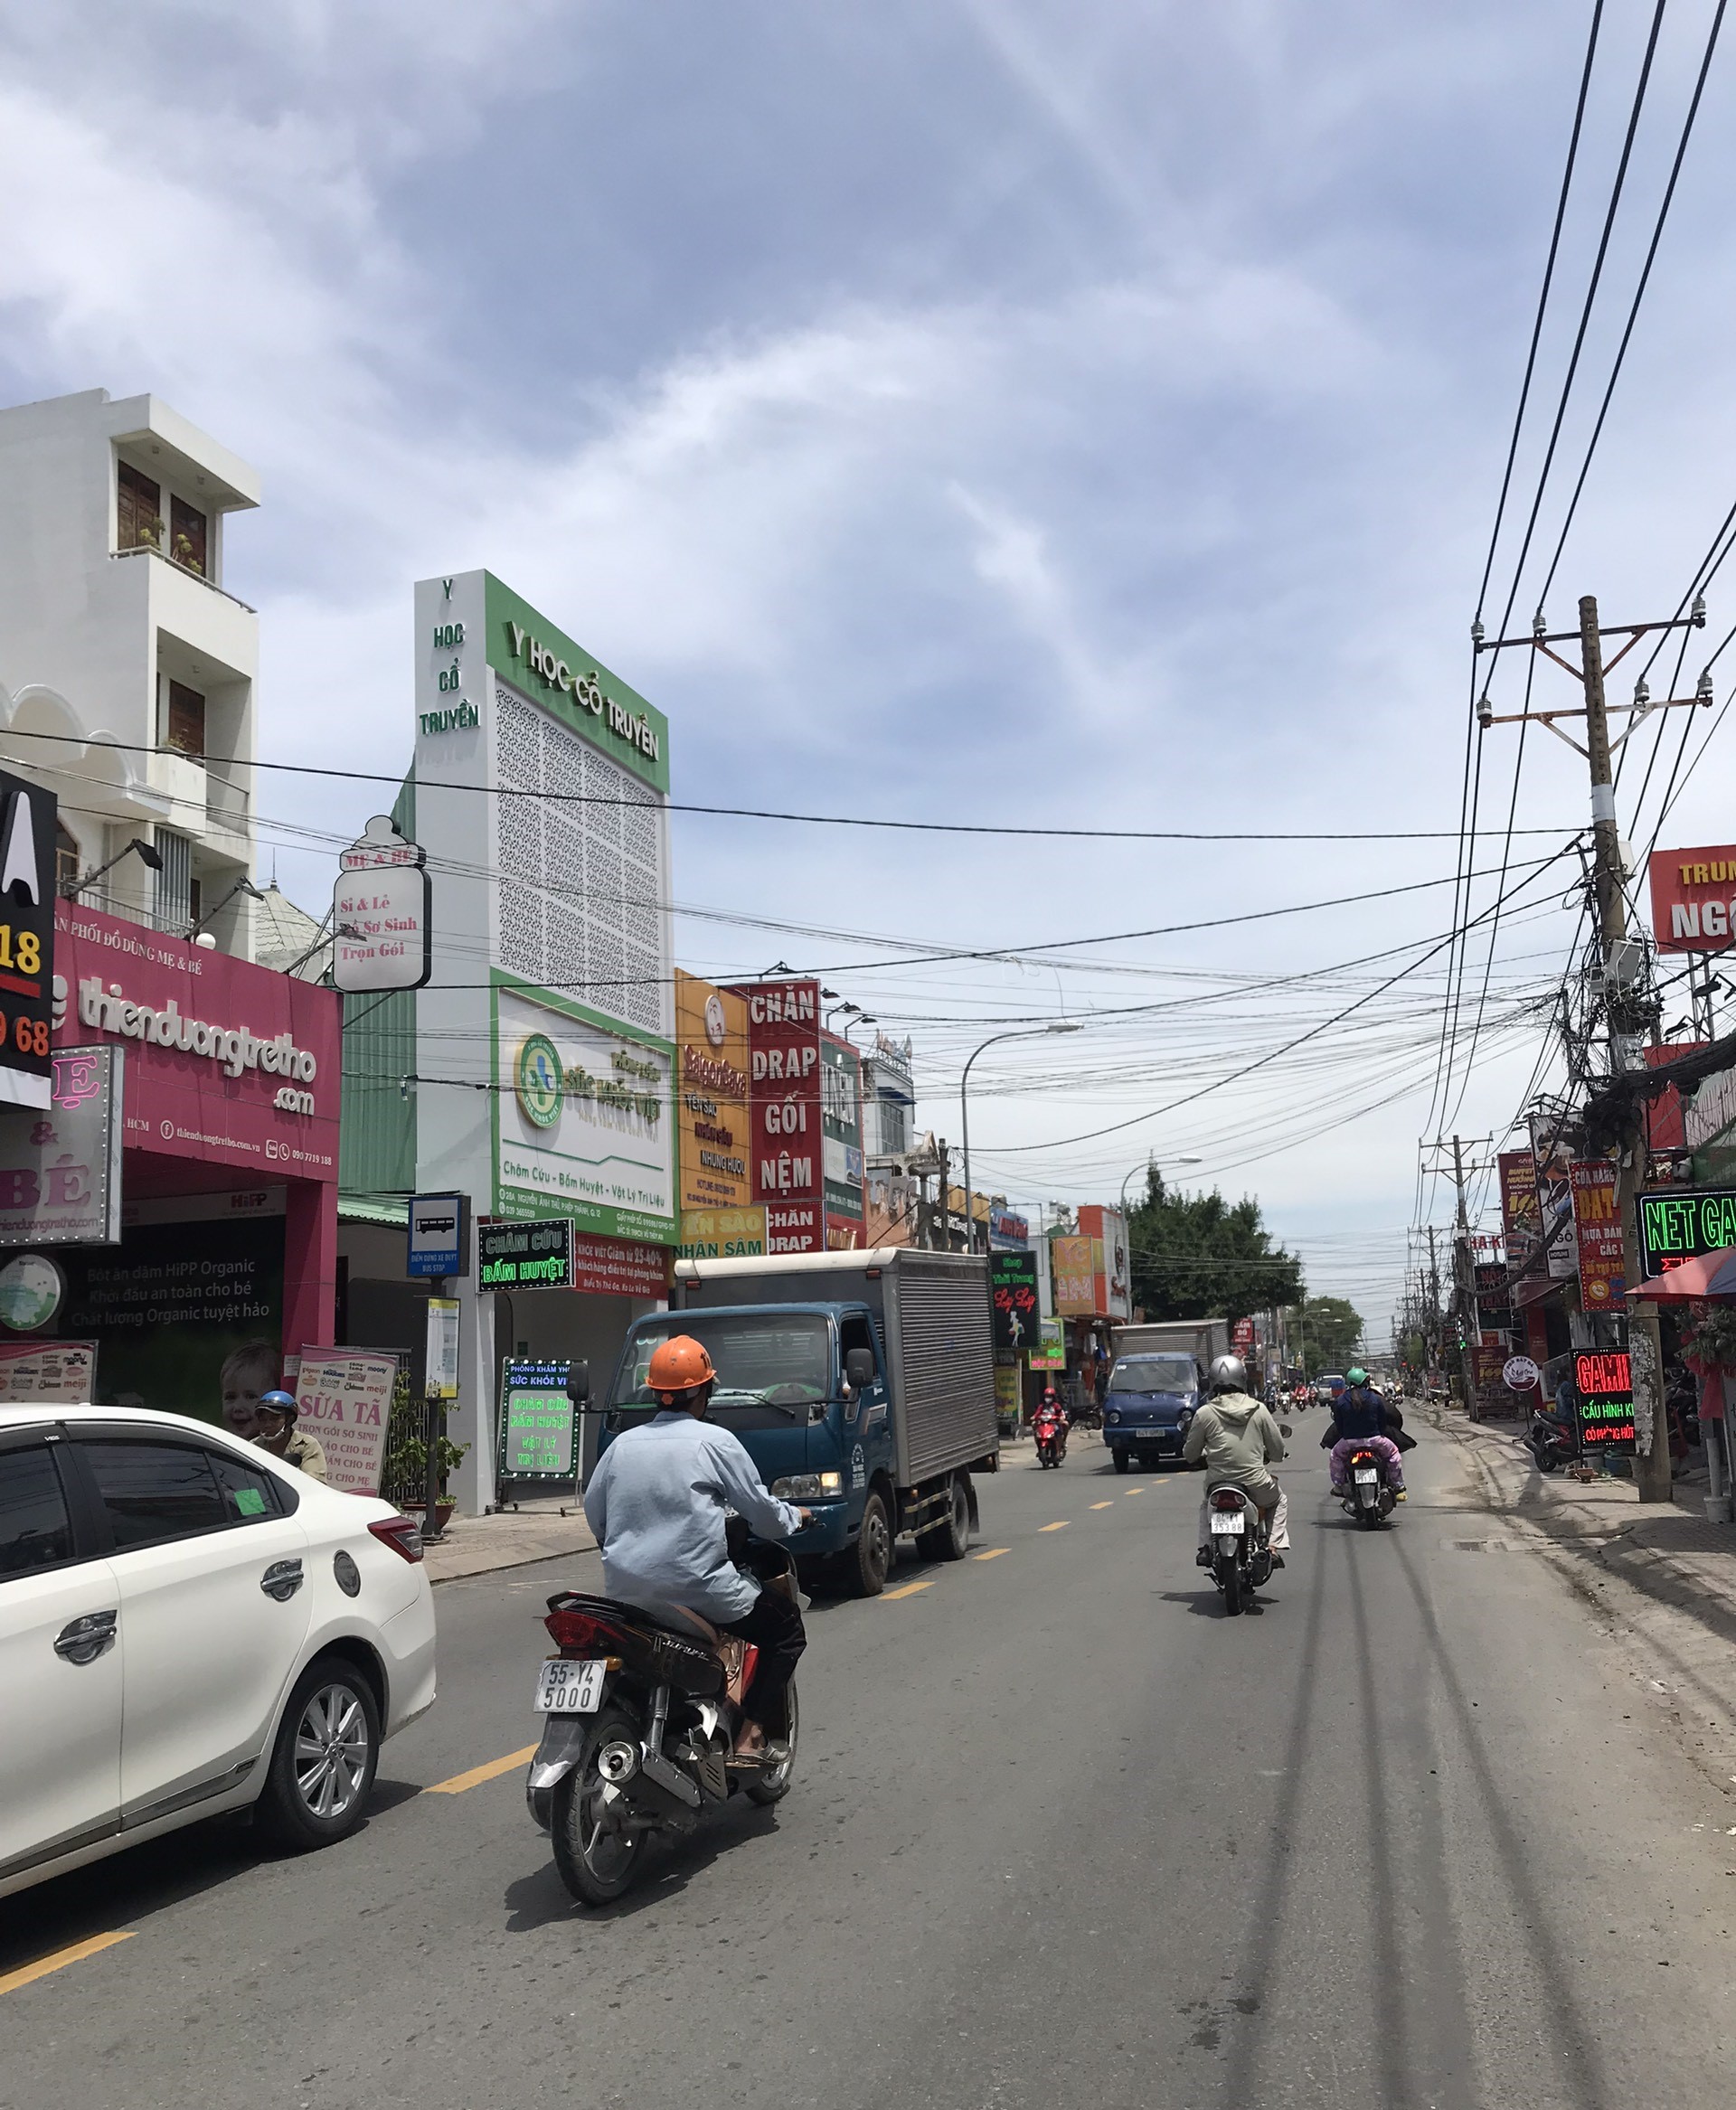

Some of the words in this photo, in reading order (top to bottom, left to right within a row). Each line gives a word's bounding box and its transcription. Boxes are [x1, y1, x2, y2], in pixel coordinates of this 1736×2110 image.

[442, 579, 453, 600] Y
[433, 623, 465, 650] HỌC
[439, 657, 461, 692] CỔ
[506, 620, 525, 657] Y
[527, 636, 571, 692] HỌC
[574, 670, 603, 716] CỔ
[606, 696, 660, 762] TRUYỀN
[419, 699, 480, 735] TRUYỀN
[373, 852, 385, 864] &
[357, 898, 369, 911] &
[384, 916, 418, 932] Sinh
[71, 921, 101, 945] PHỐI
[103, 929, 121, 950] ĐỒ
[122, 937, 156, 962] DÙNG
[156, 949, 175, 970] MẸ
[177, 956, 186, 971] &
[188, 958, 203, 976] BÉ
[340, 946, 375, 964] Trọn
[379, 941, 404, 957] Gói
[750, 984, 815, 1024] CHĂN
[78, 976, 317, 1083] thienduongtretho
[752, 1047, 817, 1081] DRAP
[273, 1087, 316, 1116] .com
[765, 1089, 807, 1135] GỐI
[127, 1117, 150, 1132] HCM
[305, 1152, 320, 1164] 7719
[701, 1149, 726, 1170] NHUNG
[503, 1160, 530, 1179] Châm
[532, 1166, 550, 1183] Cứu
[559, 1172, 578, 1189] Bấm
[579, 1177, 604, 1196] Huyệt
[649, 1192, 665, 1209] Liệu
[760, 1150, 813, 1197] NỆM
[719, 1211, 761, 1233] SÀO
[1646, 1200, 1696, 1251] NET
[486, 1231, 529, 1256] CHÂM
[531, 1229, 562, 1251] CỨU
[674, 1239, 719, 1258] NHÂN
[724, 1237, 762, 1258] SÂM
[201, 1258, 256, 1277] Organic
[483, 1262, 516, 1284] BẤM
[519, 1257, 565, 1282] HUYỆT
[150, 1288, 168, 1300] an
[171, 1283, 203, 1299] toàn
[205, 1282, 231, 1297] cho
[234, 1279, 252, 1295] bé
[146, 1305, 201, 1323] Organic
[203, 1299, 241, 1322] tuyệt
[242, 1300, 270, 1317] hảo
[510, 1363, 535, 1373] PHÒNG
[536, 1363, 557, 1373] KHÁM
[366, 1385, 387, 1396] meiji
[509, 1374, 529, 1386] SỨC
[530, 1373, 555, 1386] KHỎE
[297, 1391, 344, 1422] SỮA
[354, 1398, 382, 1427] TÃ
[1582, 1399, 1601, 1419] CẤU
[1601, 1399, 1624, 1418] HÌNH
[323, 1424, 340, 1438] GÓI
[342, 1428, 355, 1439] SƠ
[357, 1429, 378, 1443] SINH
[1585, 1425, 1597, 1441] CÓ
[340, 1443, 360, 1455] CHO
[363, 1446, 374, 1456] BÉ
[344, 1458, 363, 1470] CHO
[365, 1459, 378, 1472] BÉ
[335, 1473, 356, 1484] CHO
[548, 1663, 594, 1685] 55-Y4
[543, 1687, 591, 1709] 5000
